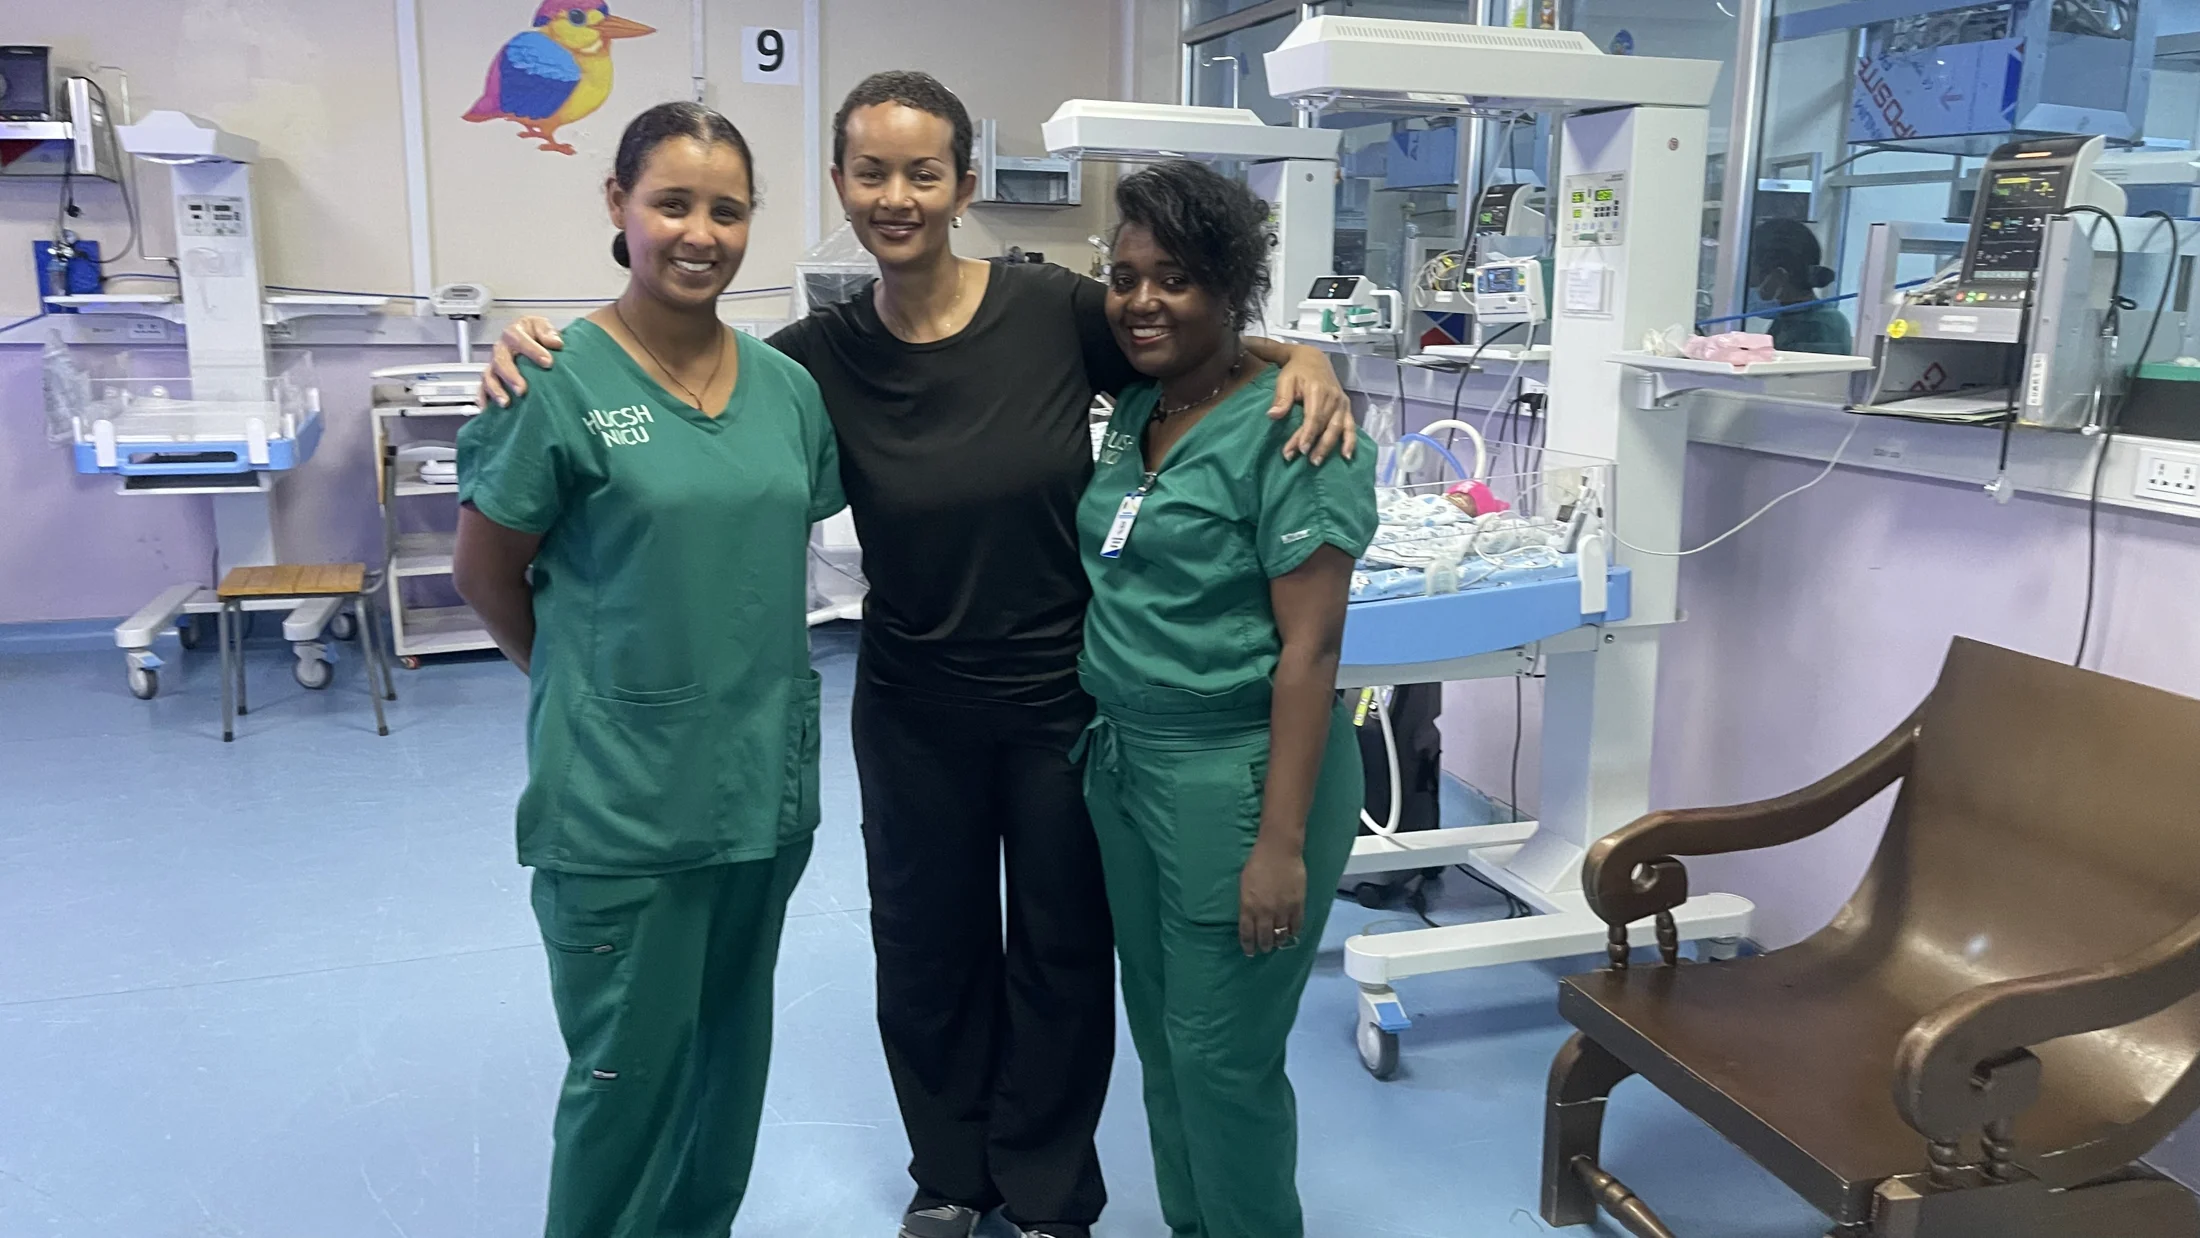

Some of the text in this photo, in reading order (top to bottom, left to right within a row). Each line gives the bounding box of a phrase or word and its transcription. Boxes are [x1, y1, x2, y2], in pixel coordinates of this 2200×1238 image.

[757, 29, 784, 72] 9
[581, 404, 655, 436] HUCSH
[600, 425, 650, 448] NICU
